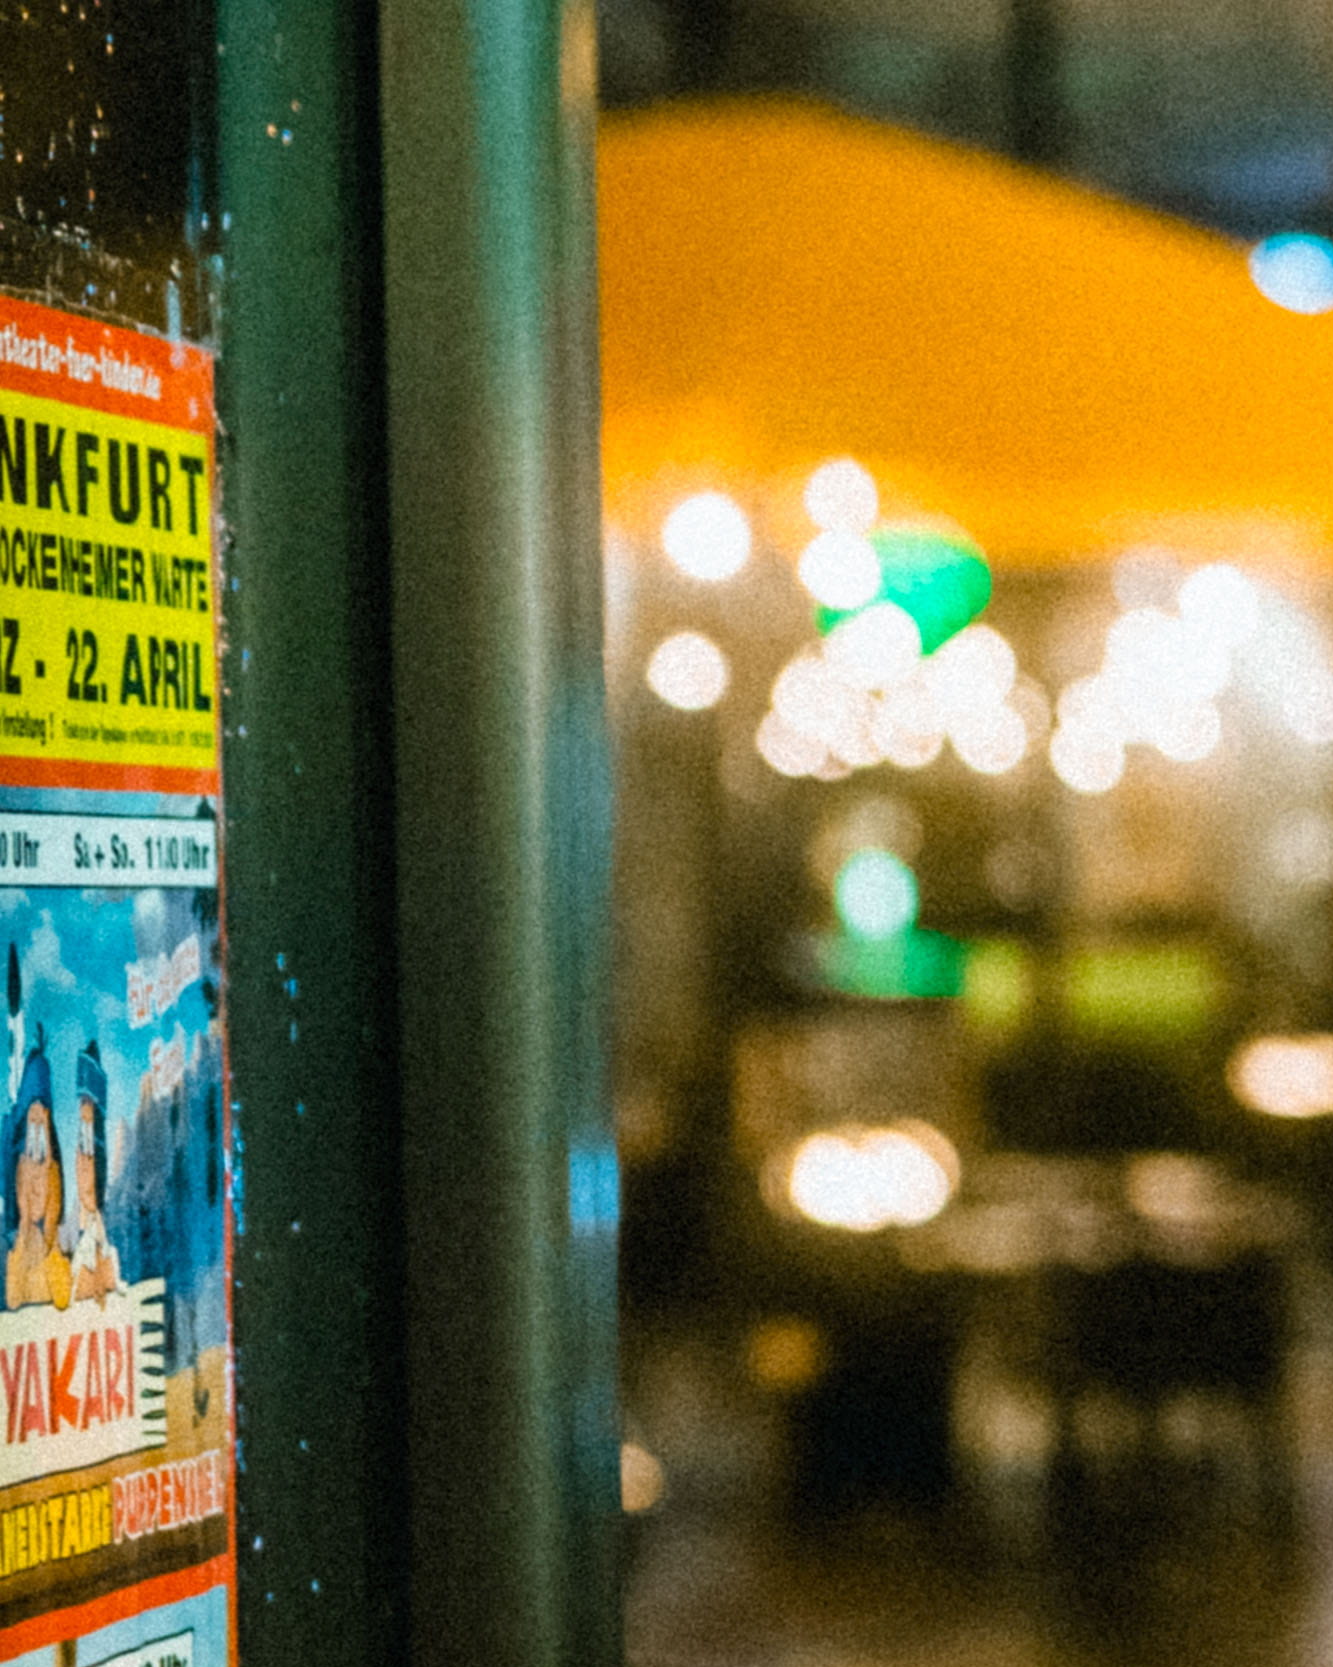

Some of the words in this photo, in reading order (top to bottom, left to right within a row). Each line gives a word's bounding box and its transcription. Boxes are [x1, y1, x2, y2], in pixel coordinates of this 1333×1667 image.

[66, 626, 108, 704] 22.
[120, 633, 212, 712] APRIL
[13, 831, 40, 870] Uhr
[94, 845, 105, 869] +
[181, 836, 210, 870] Uhr
[0, 1324, 134, 1444] YAKARI
